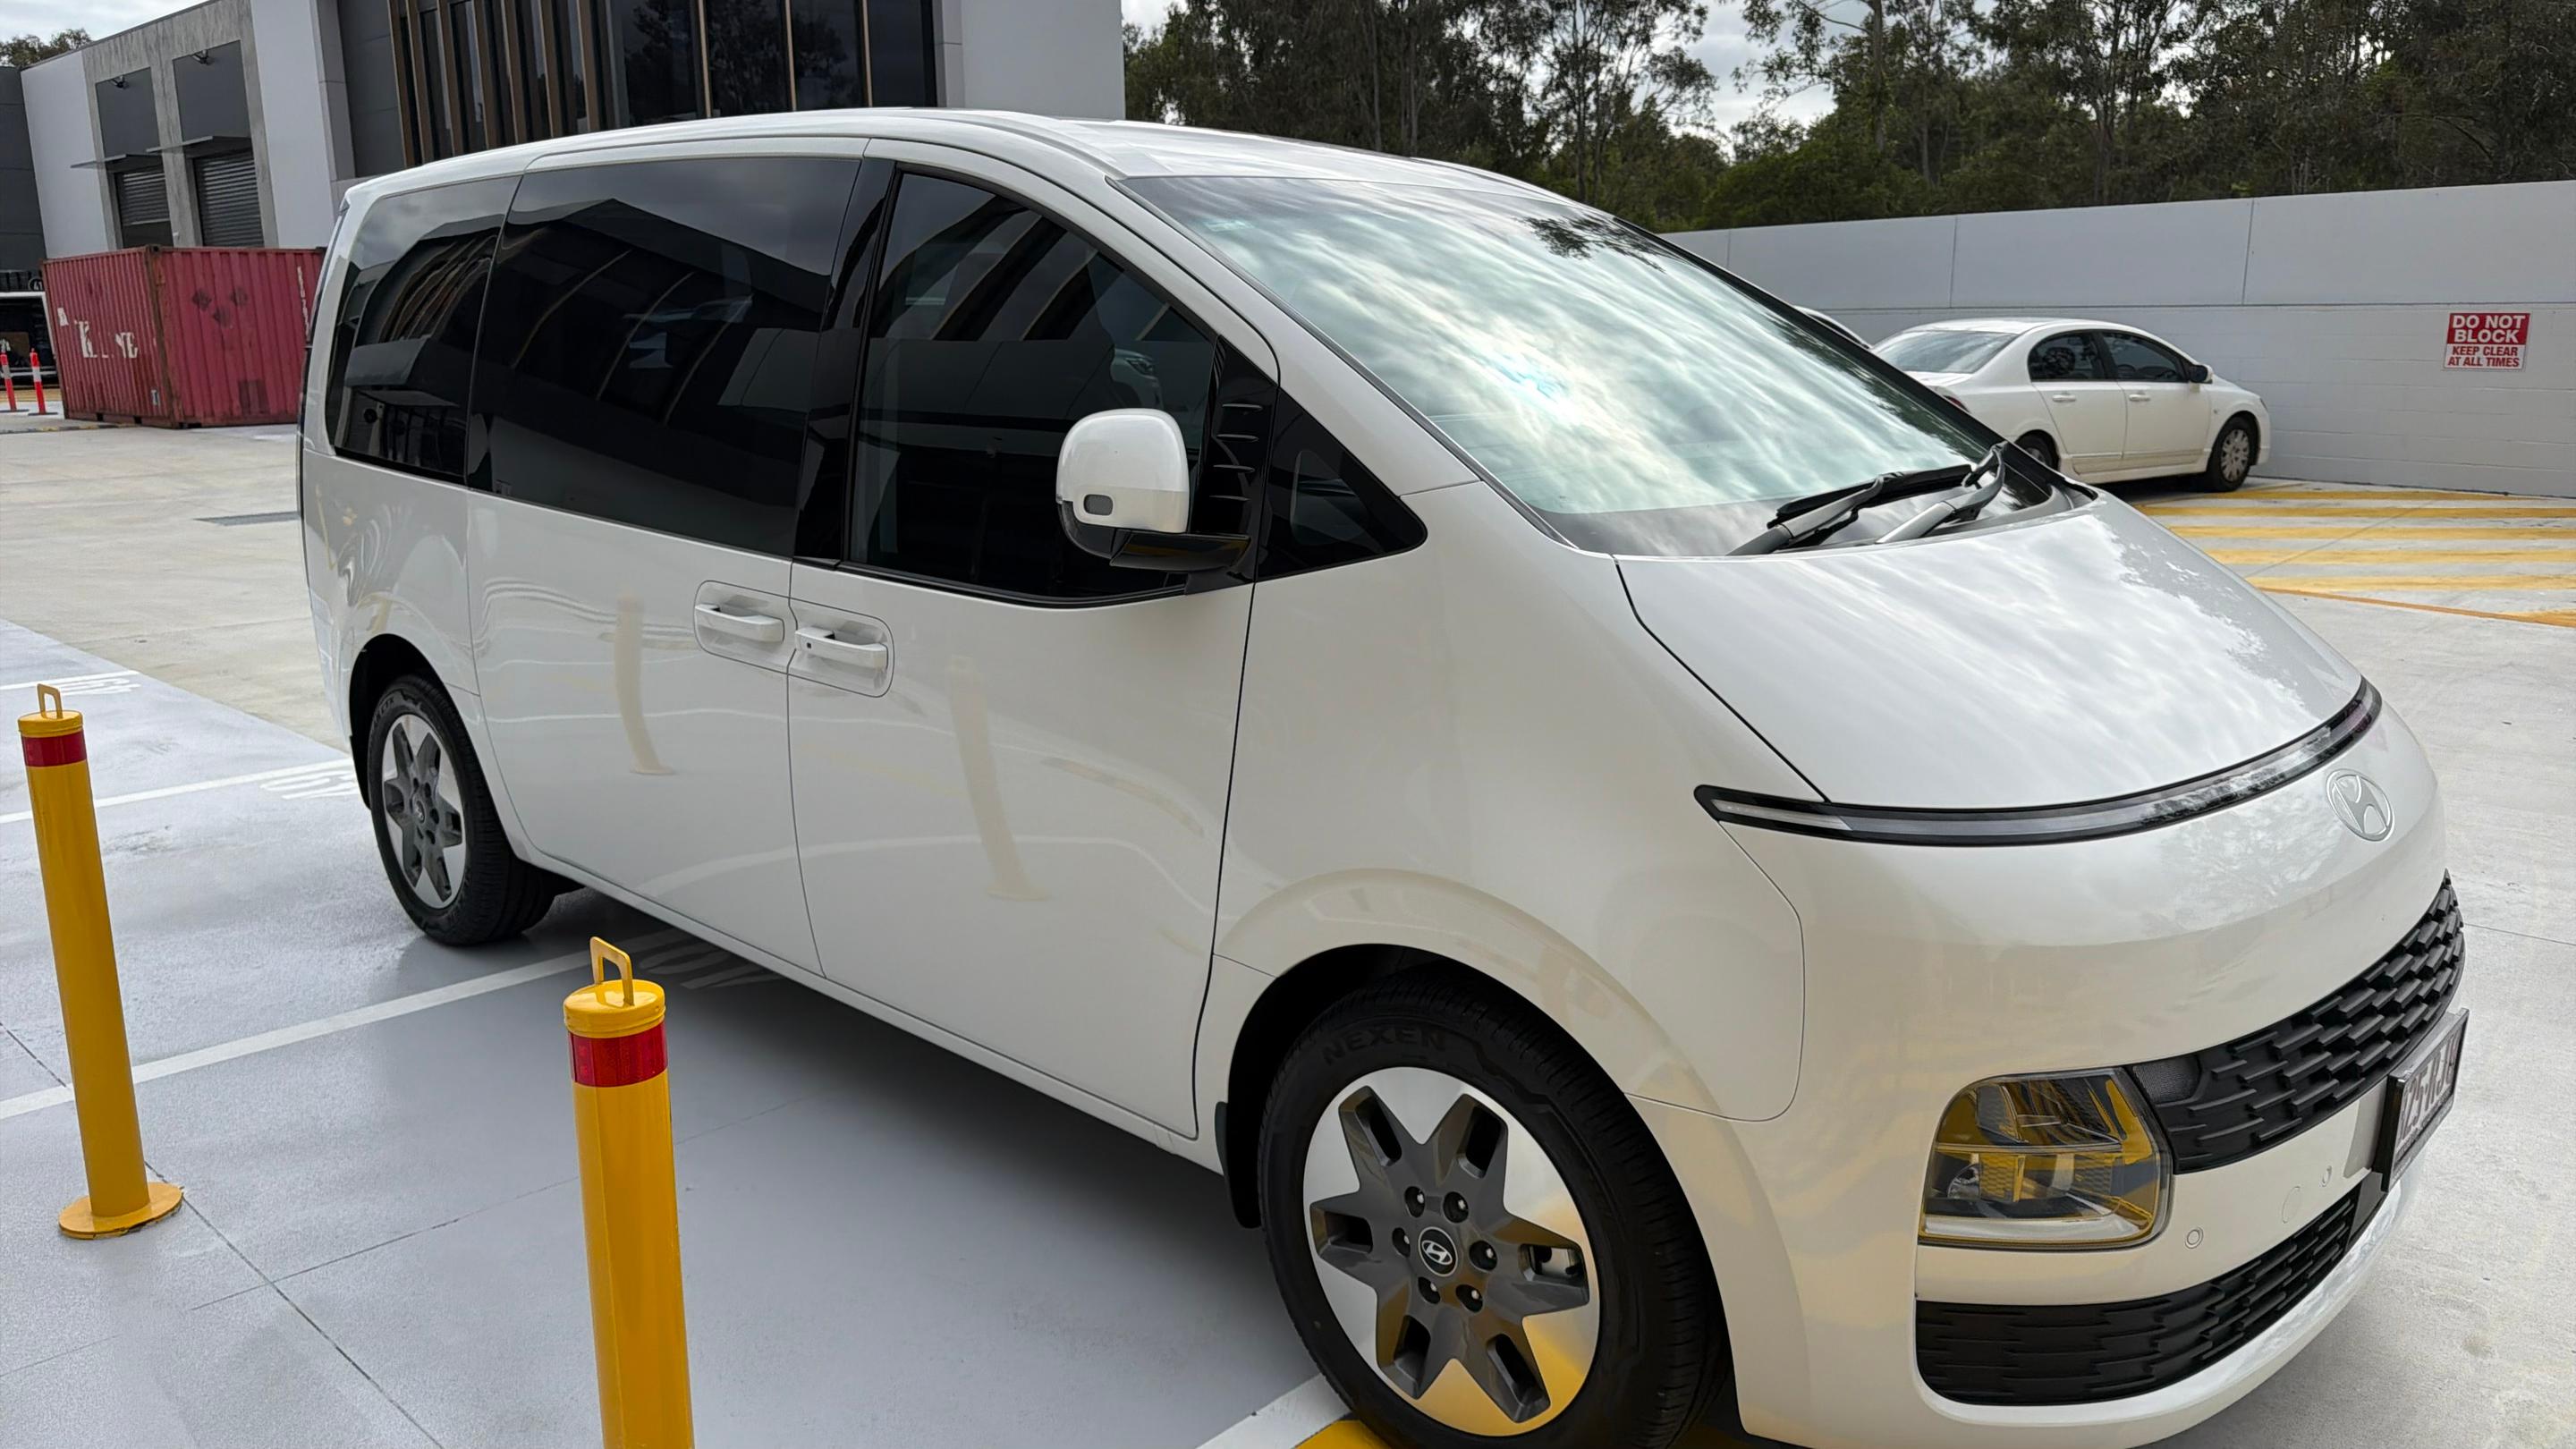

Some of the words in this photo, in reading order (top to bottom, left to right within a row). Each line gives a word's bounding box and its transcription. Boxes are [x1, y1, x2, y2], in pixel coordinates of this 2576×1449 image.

[2452, 315, 2480, 329] DO
[2485, 315, 2526, 329] NOT
[2453, 329, 2519, 343] BLOCK
[2452, 345, 2479, 356] KEEP
[2483, 345, 2518, 356] CLEAR
[2447, 356, 2462, 366] AT
[2463, 356, 2483, 367] ALL
[2486, 357, 2520, 368] TIMES
[1321, 1027, 1446, 1066] NEXEN
